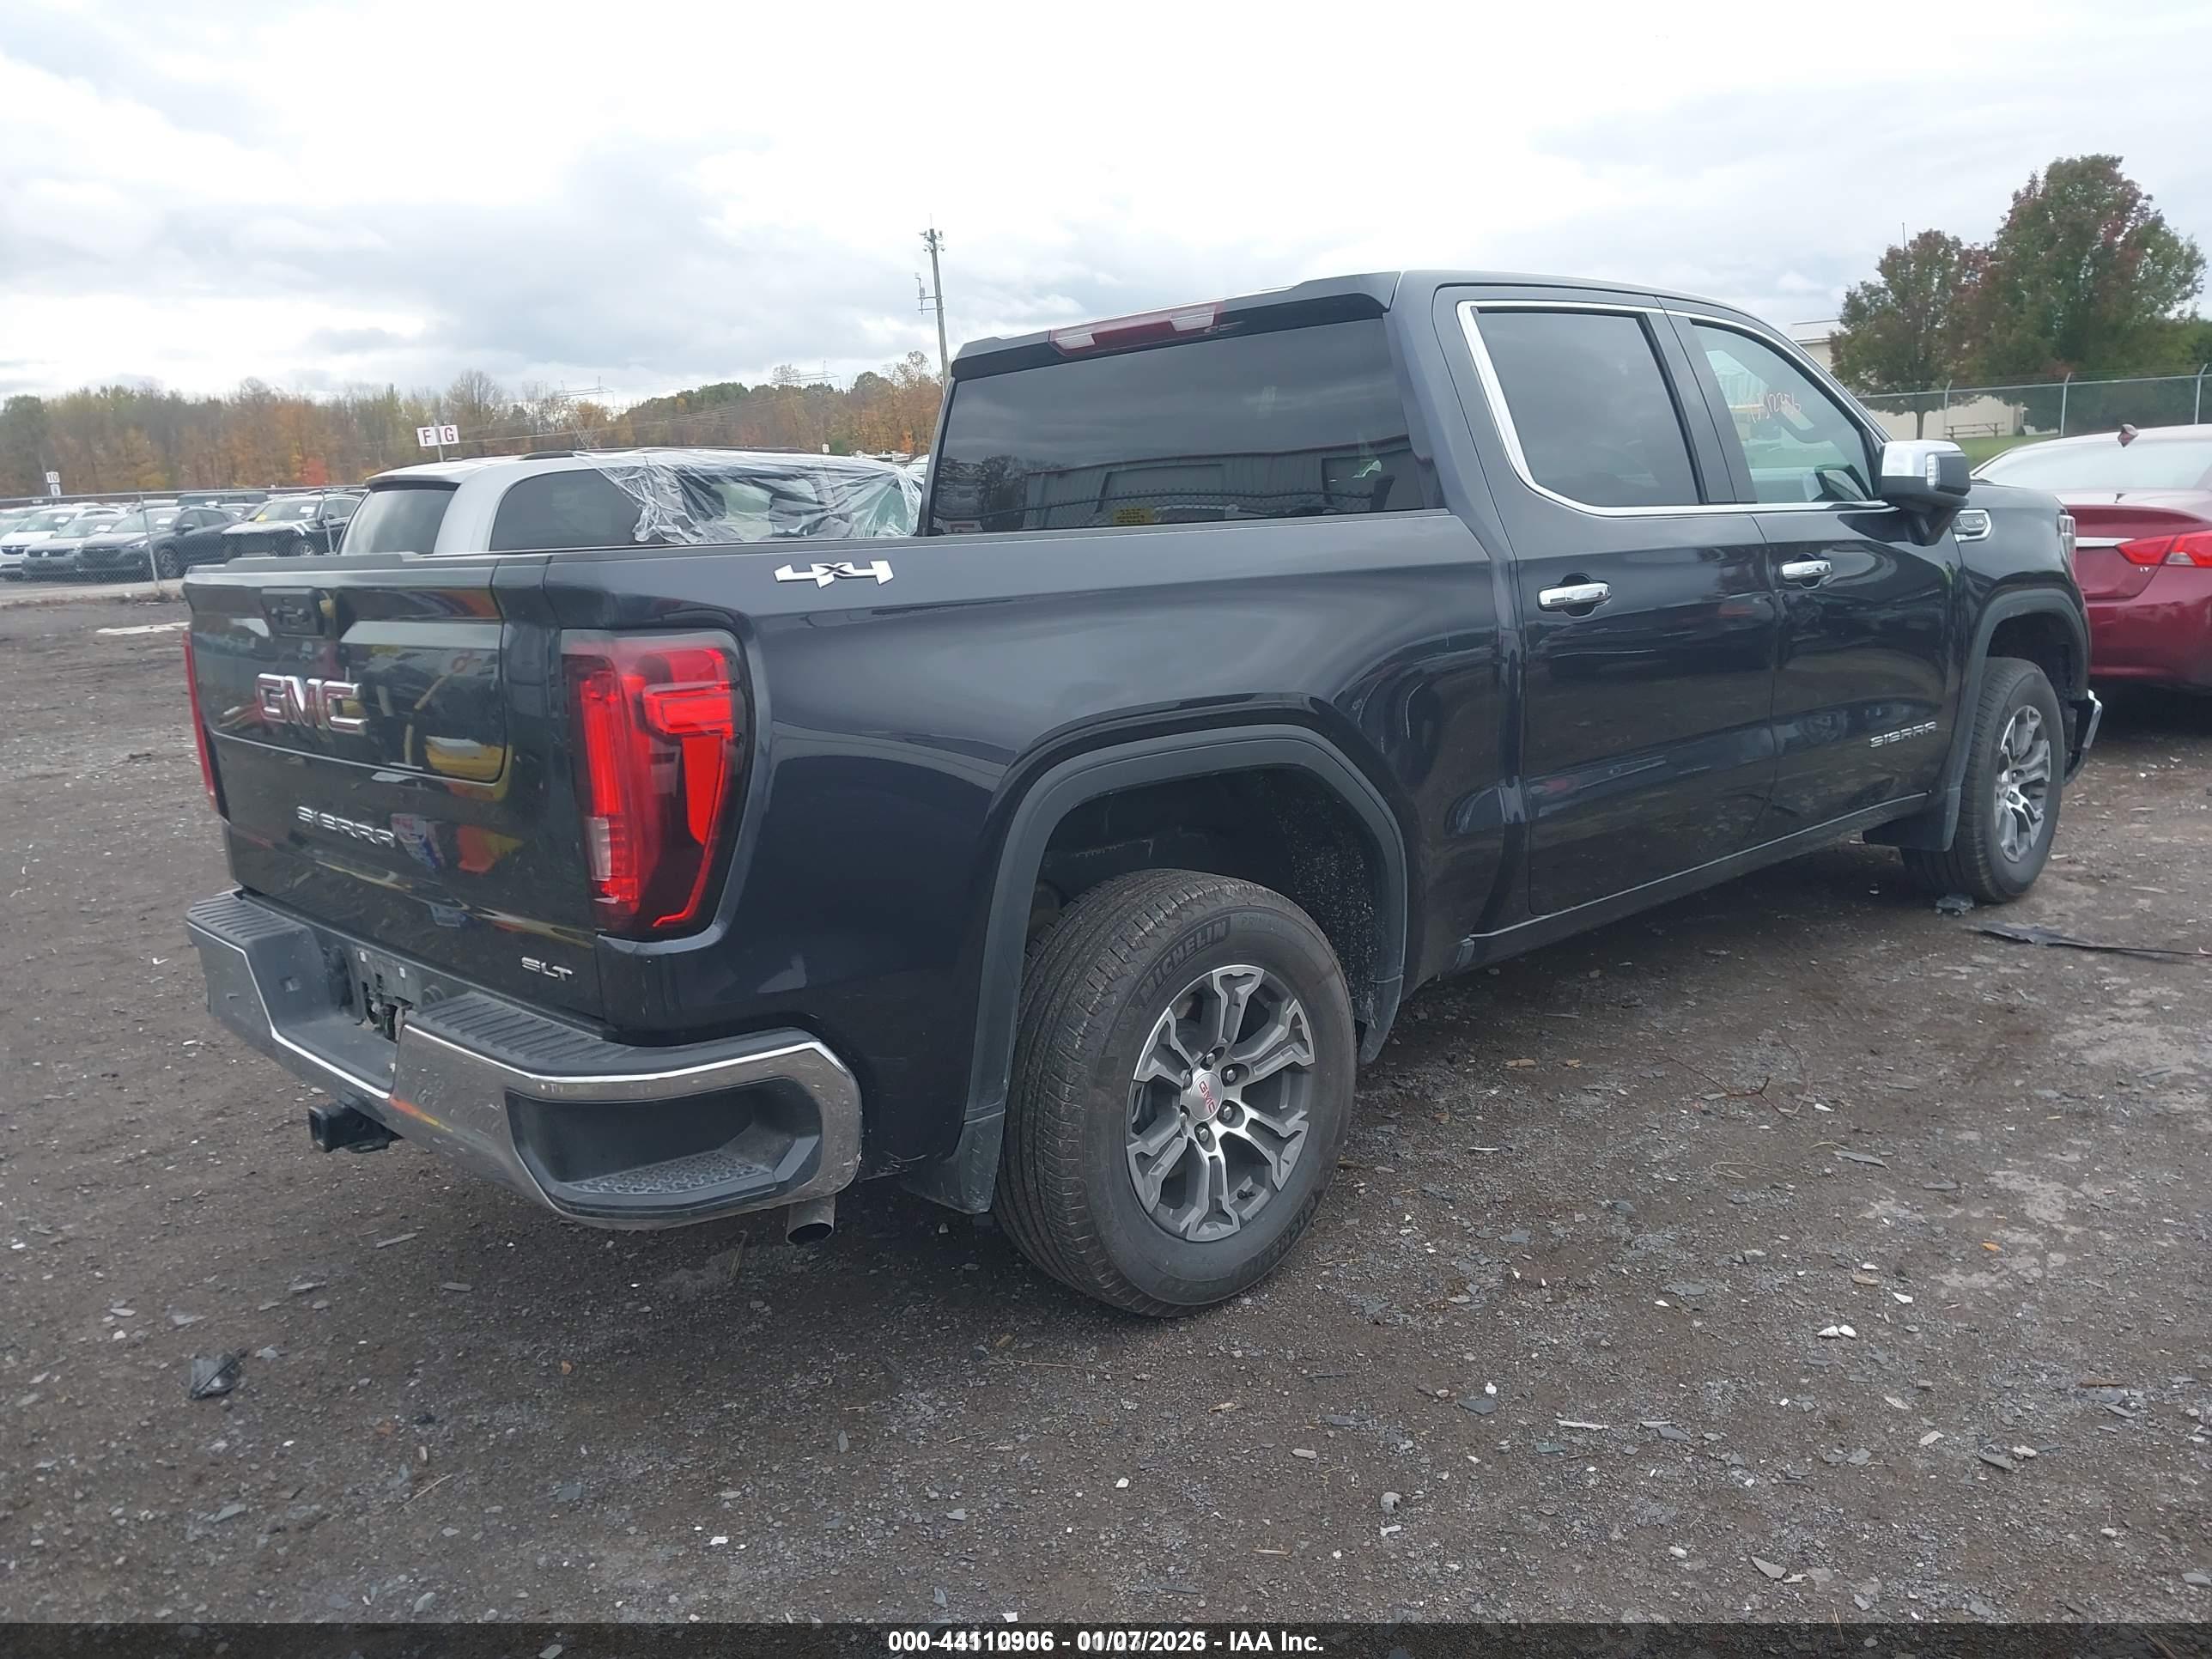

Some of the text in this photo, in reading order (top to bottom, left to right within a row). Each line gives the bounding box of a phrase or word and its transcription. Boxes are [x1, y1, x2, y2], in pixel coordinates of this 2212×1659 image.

[422, 427, 455, 445] F G
[47, 472, 58, 482] 10
[257, 672, 370, 736] GMC
[1869, 721, 1937, 748] SIERRA
[296, 805, 396, 848] SIERRA
[520, 956, 574, 981] SLT
[1139, 921, 1229, 1003] MICHELIN
[1199, 1080, 1216, 1114] GMC
